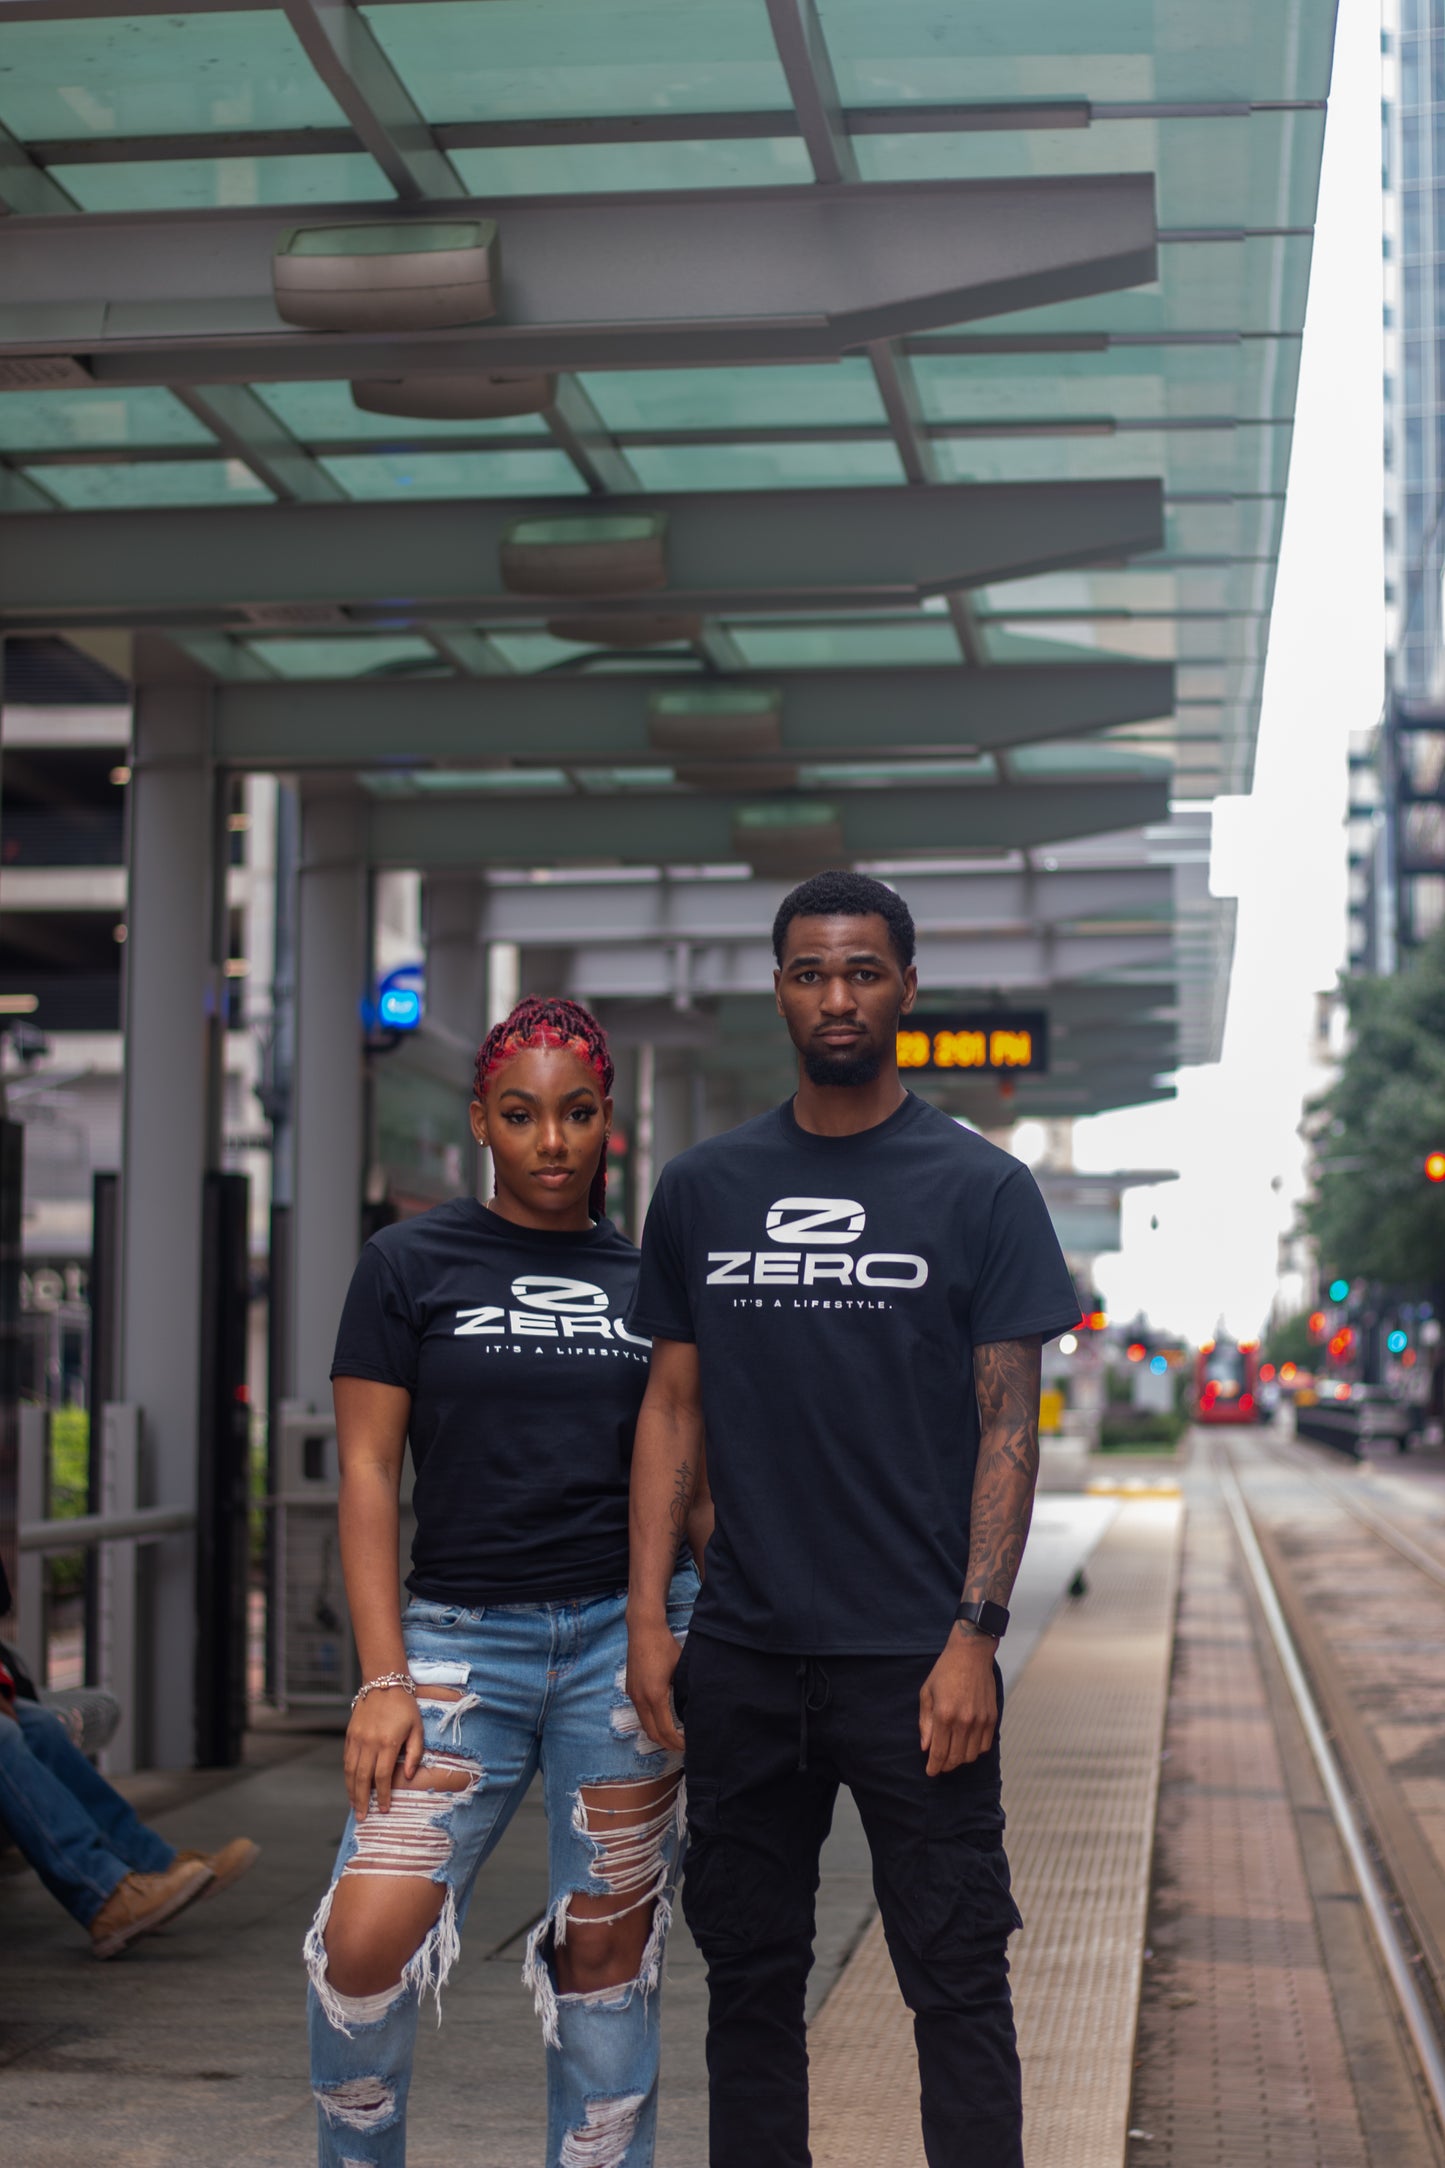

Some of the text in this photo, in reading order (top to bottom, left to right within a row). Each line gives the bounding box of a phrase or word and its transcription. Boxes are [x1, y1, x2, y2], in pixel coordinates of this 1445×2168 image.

[706, 1251, 929, 1289] ZERO
[733, 1298, 893, 1310] IT'S A LIFESTYLE.
[485, 1345, 649, 1364] IT'S A LIFESTYLE
